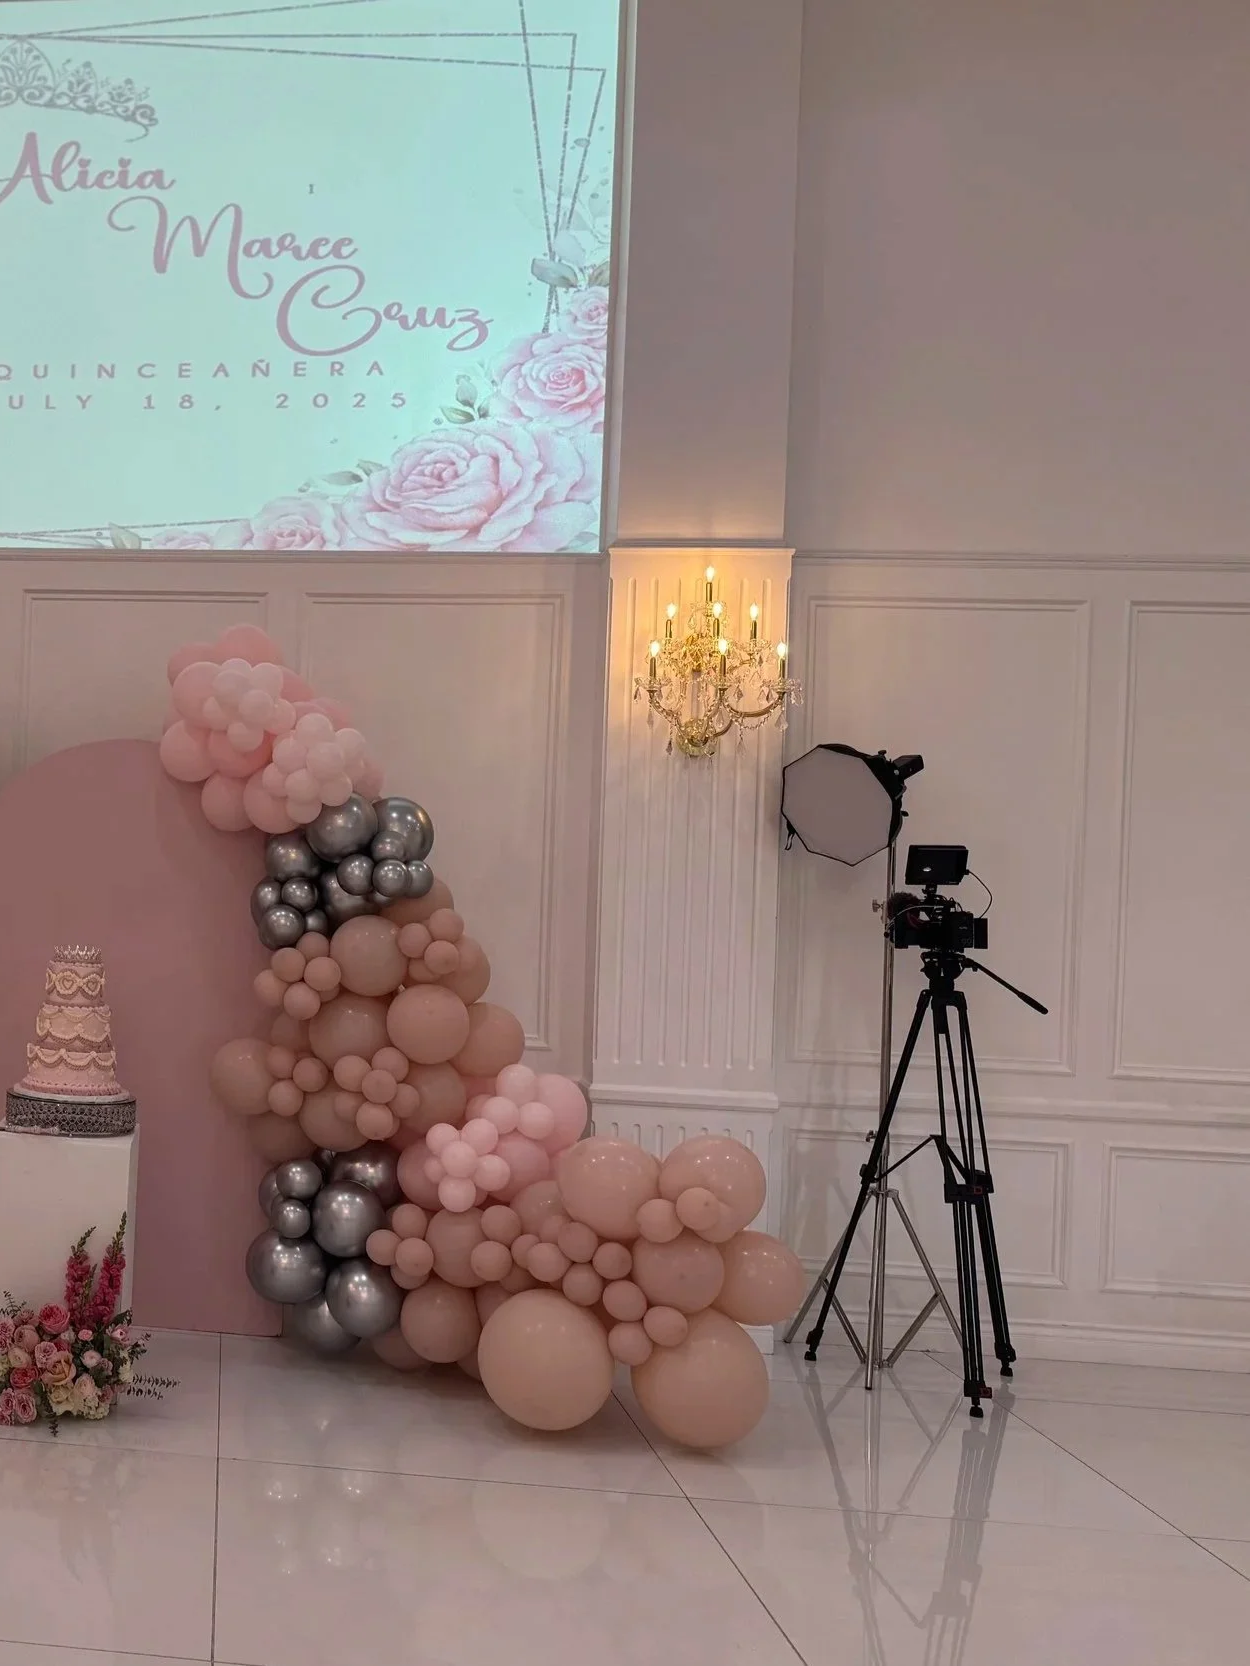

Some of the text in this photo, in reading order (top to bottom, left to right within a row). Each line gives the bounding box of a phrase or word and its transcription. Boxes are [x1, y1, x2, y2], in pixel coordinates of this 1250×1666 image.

[107, 195, 359, 300] Maree
[276, 263, 494, 357] Cruz
[142, 393, 222, 412] 18,
[275, 391, 407, 409] 2025
